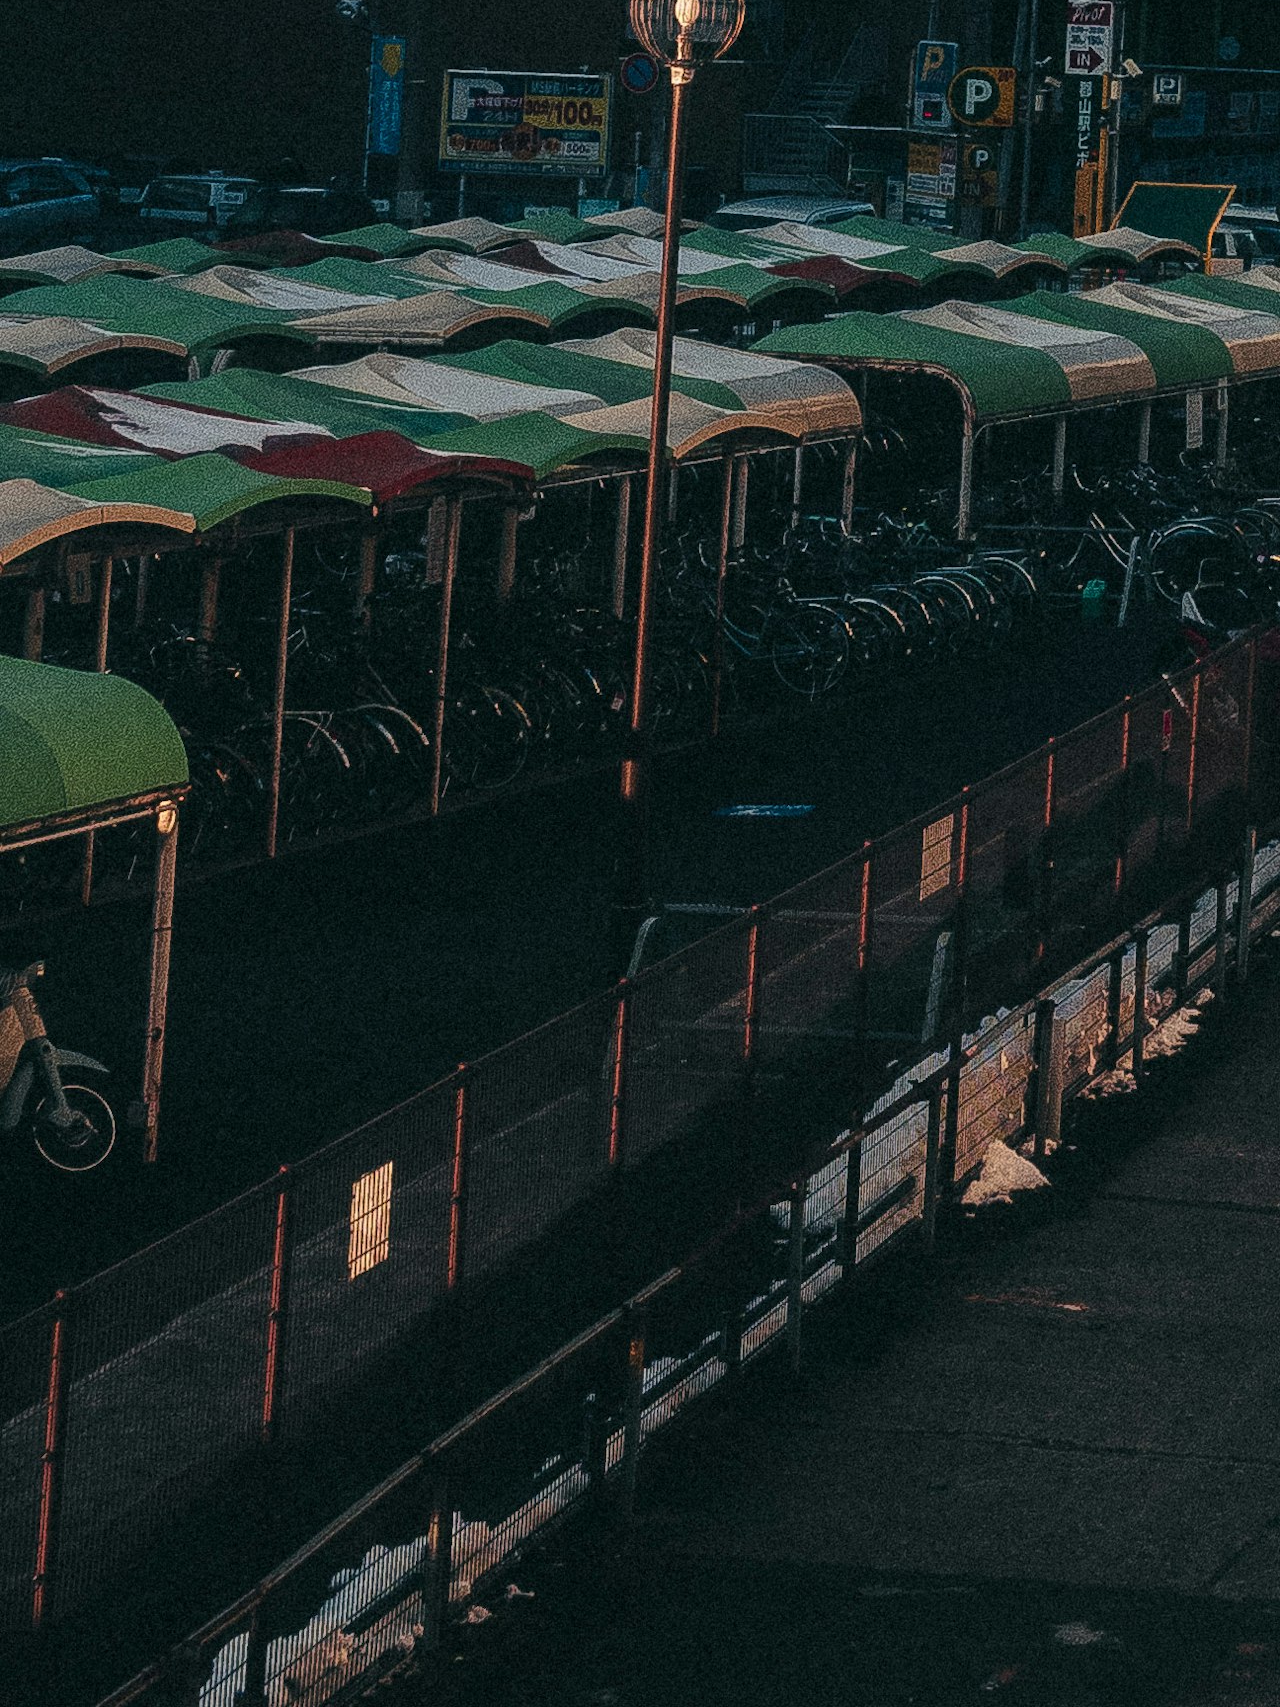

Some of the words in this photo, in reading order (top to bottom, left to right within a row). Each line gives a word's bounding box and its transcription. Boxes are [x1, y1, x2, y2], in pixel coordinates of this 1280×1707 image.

[920, 46, 945, 81] P
[1076, 53, 1091, 67] IN
[1159, 77, 1176, 93] P
[965, 78, 993, 115] P
[974, 149, 989, 168] P
